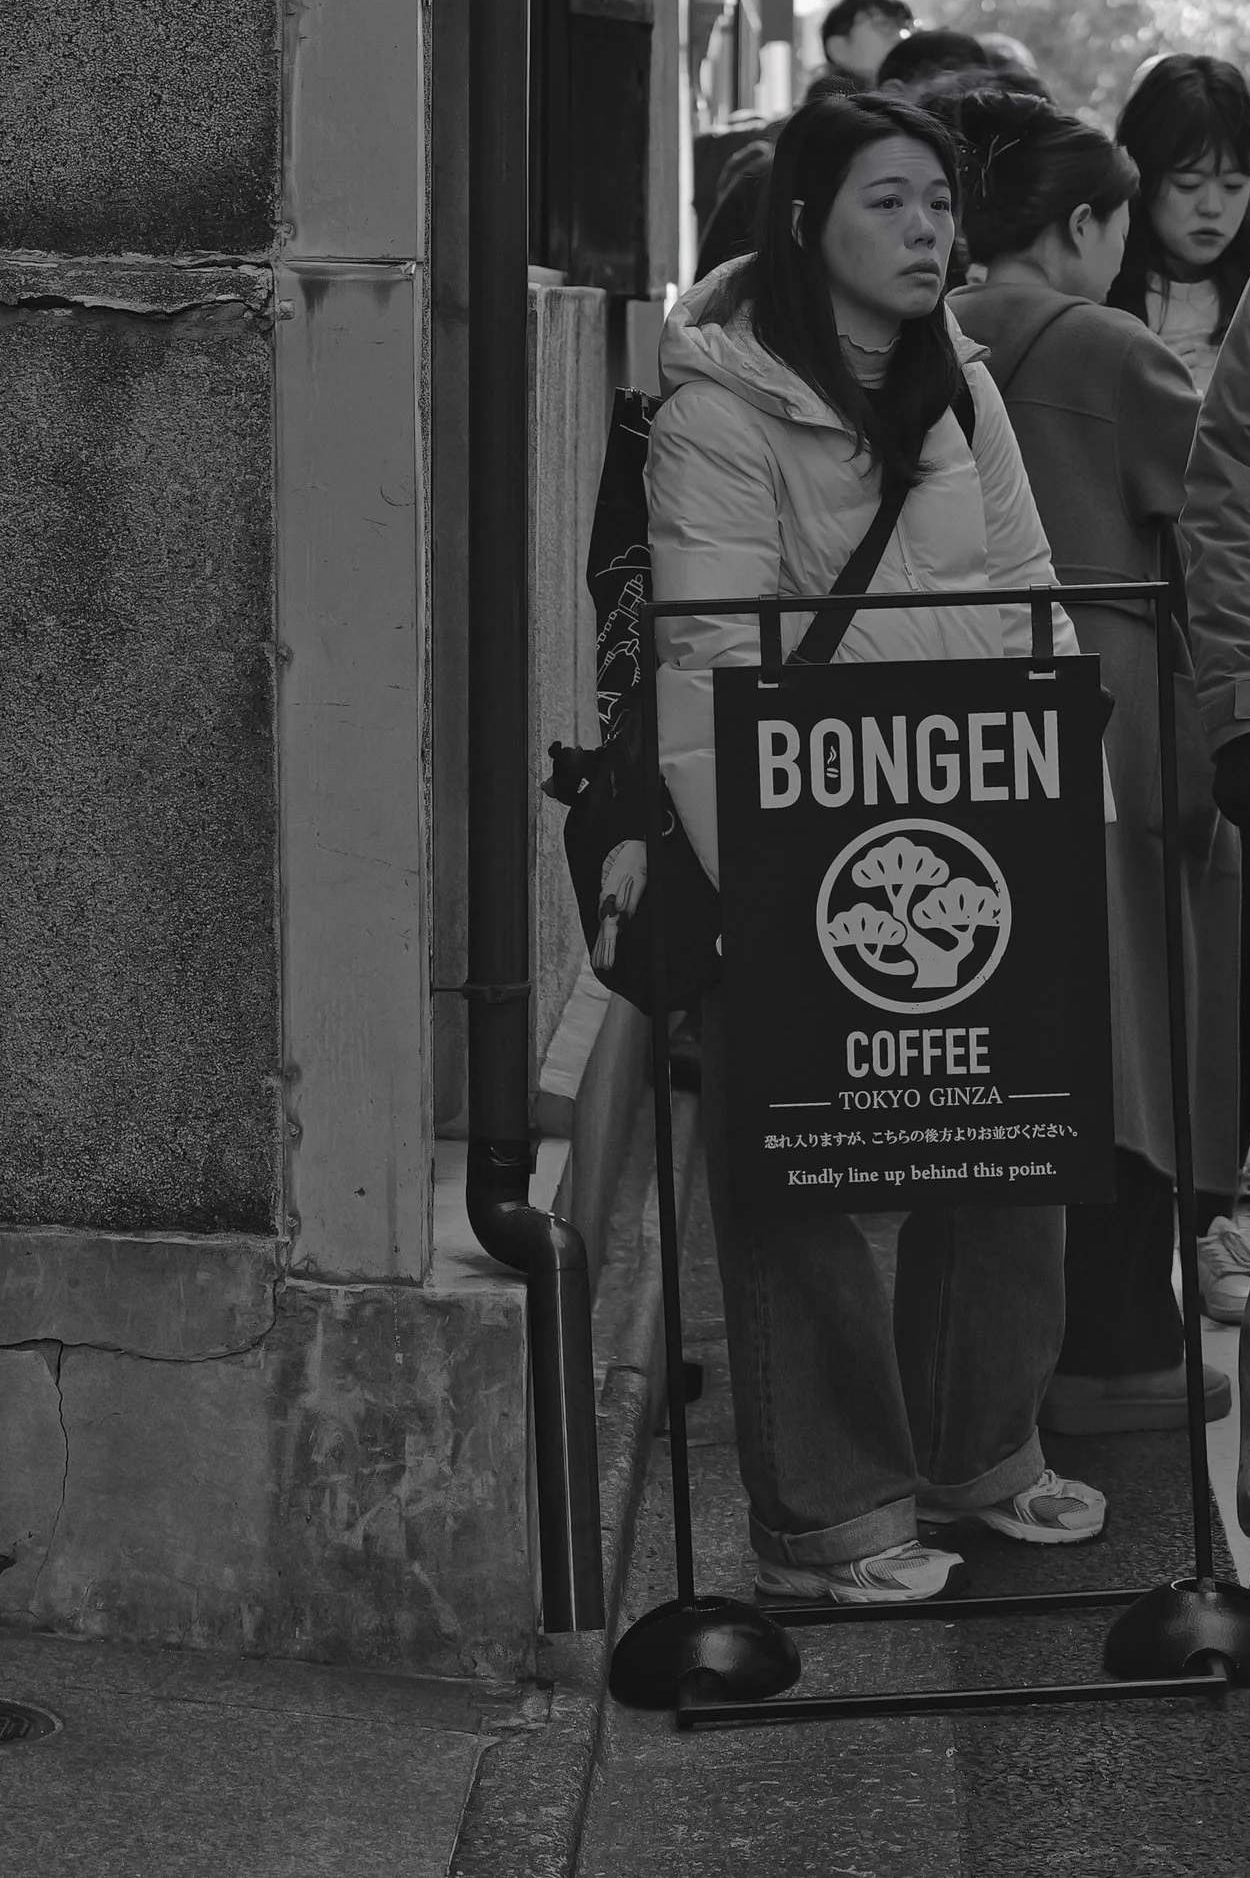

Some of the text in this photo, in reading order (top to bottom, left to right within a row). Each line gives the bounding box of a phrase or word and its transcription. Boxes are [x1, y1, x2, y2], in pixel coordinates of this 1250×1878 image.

[757, 709, 1061, 809] BONGEN
[846, 1027, 991, 1078] COFFEE
[838, 1085, 1004, 1110] TOKYO GINZA
[787, 1161, 1057, 1189] Kindly line up behind this point.
